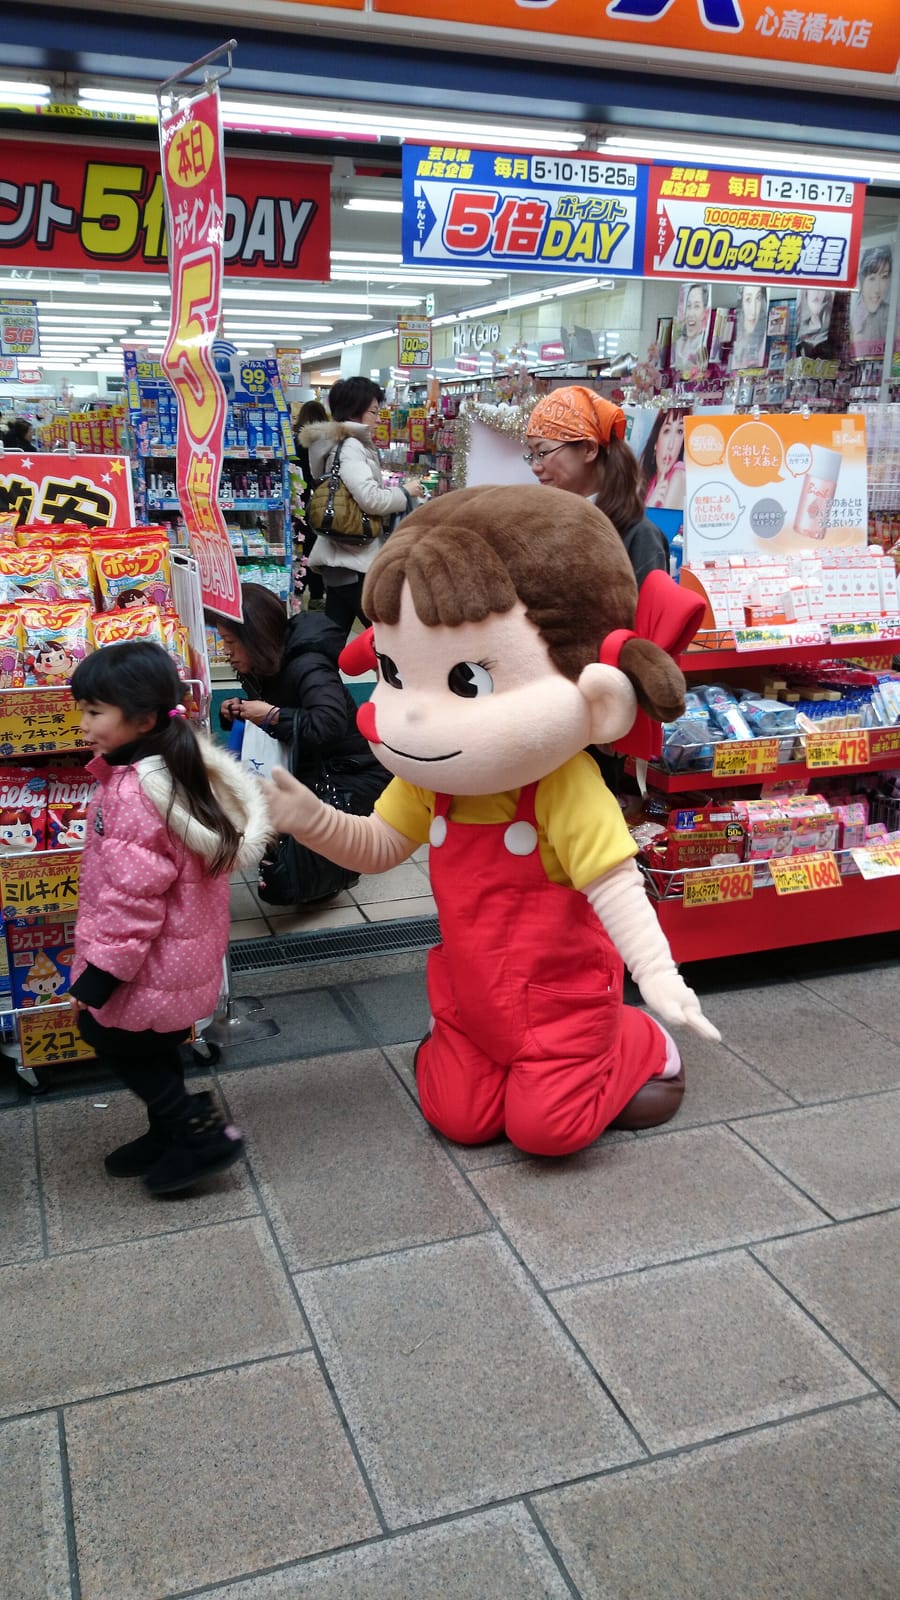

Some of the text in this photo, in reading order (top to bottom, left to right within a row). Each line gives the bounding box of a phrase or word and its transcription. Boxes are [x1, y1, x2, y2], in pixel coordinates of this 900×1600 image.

[755, 7, 873, 49] 心斎橋本店
[176, 125, 206, 182] 本日
[416, 160, 474, 179] 限定企画
[494, 157, 529, 180] 毎月
[660, 180, 710, 198] 限定企画
[728, 176, 759, 198] 毎月
[174, 189, 224, 249] ポイント
[556, 195, 627, 221] ポイント
[704, 207, 815, 232] 1000円お買上げ毎に
[444, 191, 549, 256] 5倍
[541, 220, 629, 261] DAY
[674, 226, 847, 276] 100円の金券進呈
[732, 445, 771, 457] 完治した
[743, 456, 780, 467] キズあと
[103, 549, 161, 578] ポップ
[23, 713, 66, 726] 不二家
[838, 738, 868, 763] 478
[719, 873, 752, 899] 980
[804, 862, 837, 889] 1680
[12, 930, 63, 949] シスコーン
